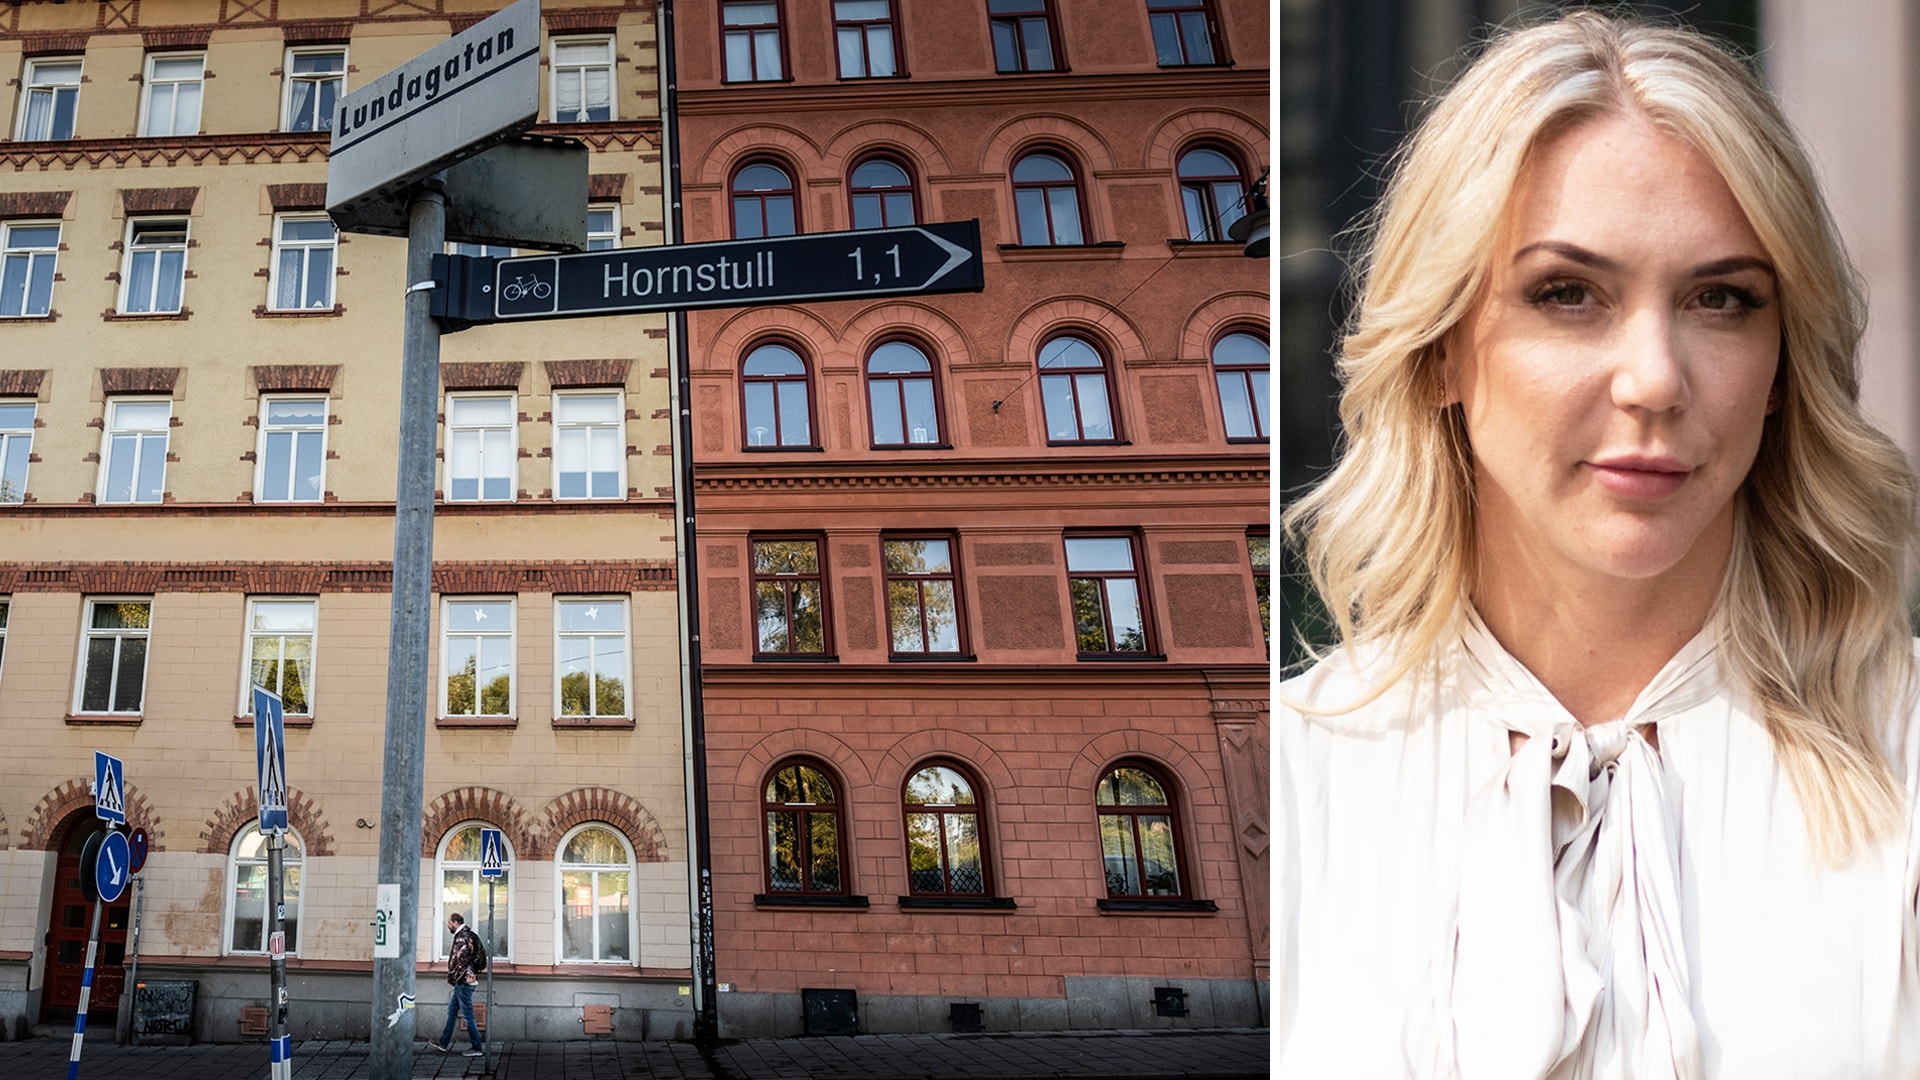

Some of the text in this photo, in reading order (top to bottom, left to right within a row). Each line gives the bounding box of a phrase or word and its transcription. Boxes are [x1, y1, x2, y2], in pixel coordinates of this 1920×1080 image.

[339, 27, 514, 138] Lundagatan
[603, 244, 901, 298] Hornstull 1,1
